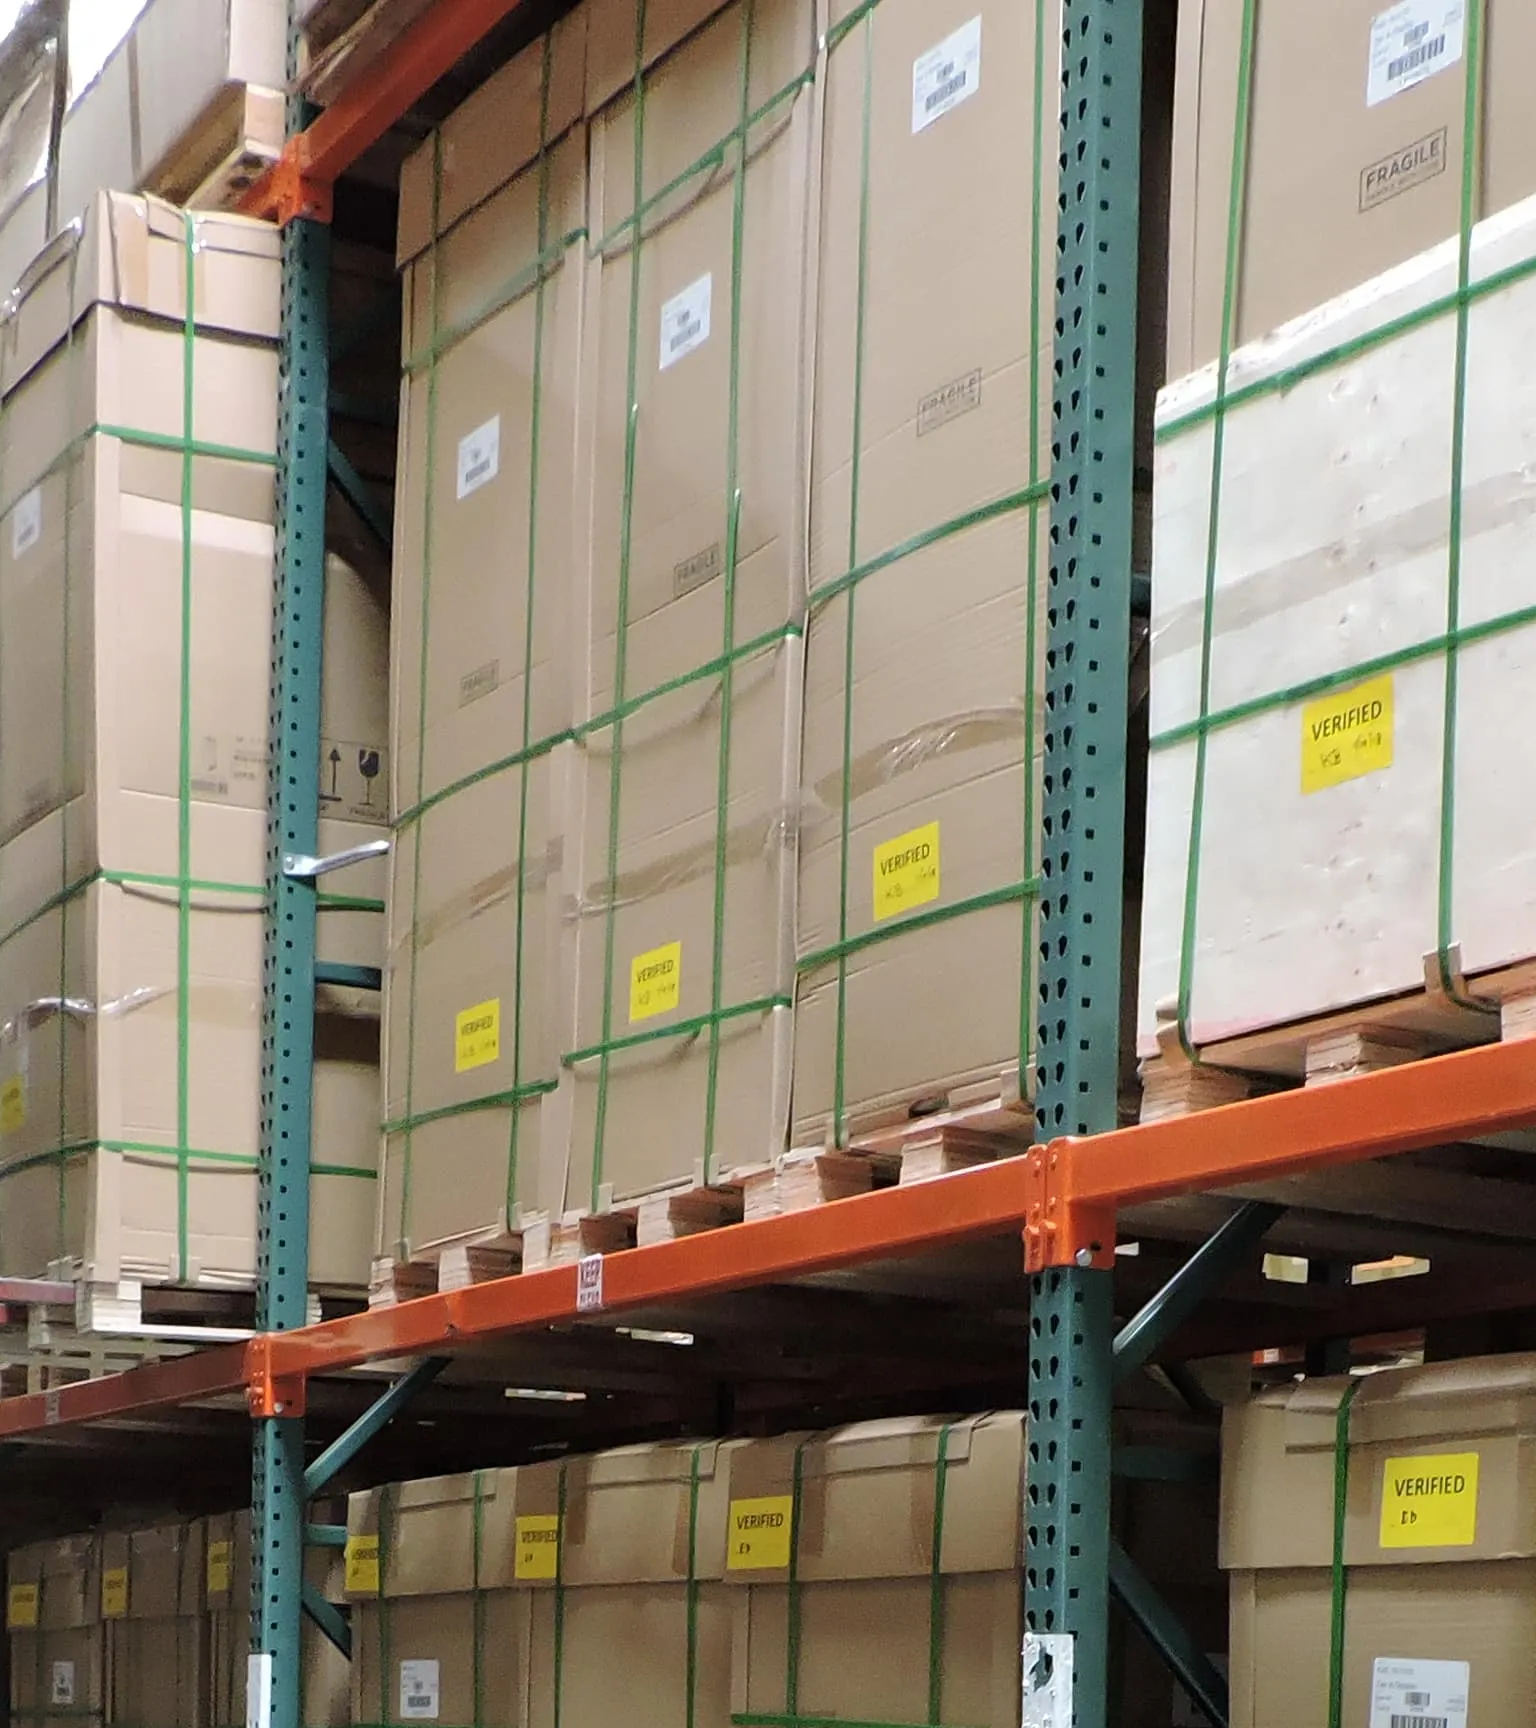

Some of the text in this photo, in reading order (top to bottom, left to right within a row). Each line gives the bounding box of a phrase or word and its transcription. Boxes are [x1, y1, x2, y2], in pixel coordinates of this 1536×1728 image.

[1366, 137, 1441, 190] FRAGILE
[1311, 700, 1383, 742] VERIFIED
[880, 843, 930, 877] VERIFIED
[636, 959, 674, 985] VERIFIED
[1394, 1475, 1465, 1497] VERIFIED
[736, 1513, 784, 1530] VERIFIED
